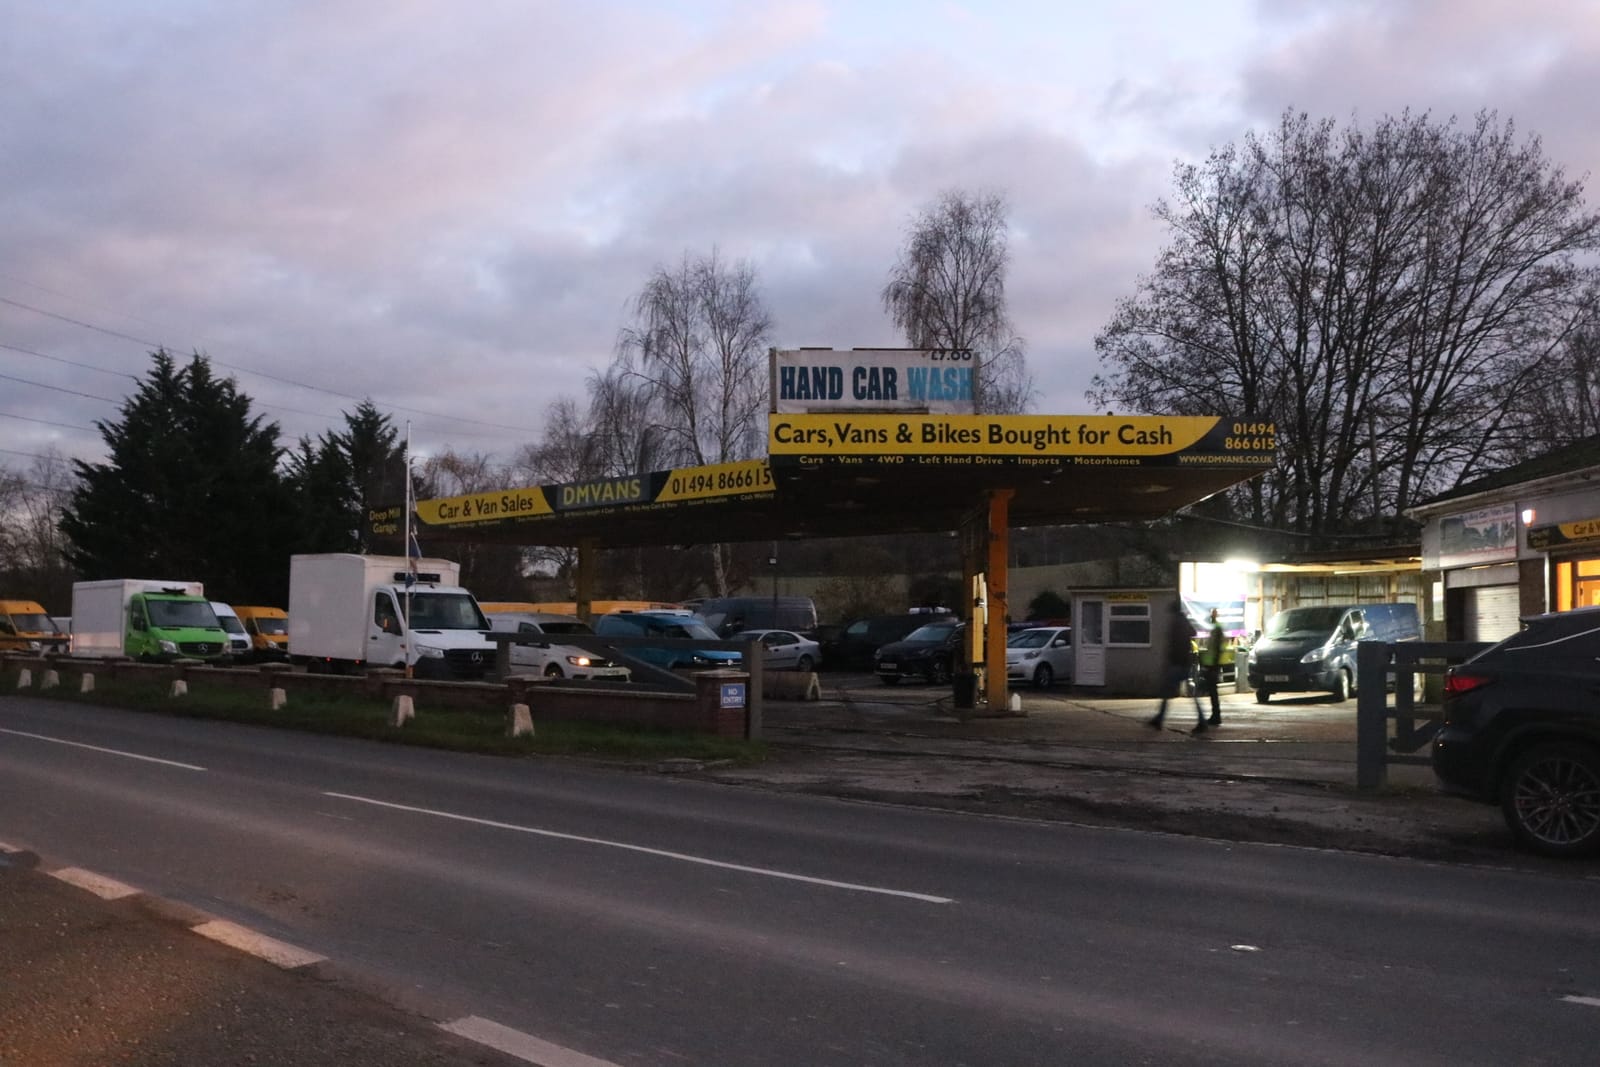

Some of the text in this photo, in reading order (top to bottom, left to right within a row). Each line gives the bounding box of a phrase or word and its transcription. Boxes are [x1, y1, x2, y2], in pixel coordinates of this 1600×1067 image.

[780, 366, 975, 401] HAND CAR WASH
[895, 423, 913, 444] &
[921, 423, 981, 444] Bikes
[988, 424, 1071, 449] Bought
[1077, 424, 1110, 445] for
[1118, 424, 1173, 445] Cash
[1233, 422, 1275, 435] 01494
[799, 456, 1141, 467] Cars Vans 4WD Left Hand Drive Imports Motorhomes
[563, 478, 641, 506] DMVANS
[672, 467, 771, 494] 01494 866615
[438, 495, 533, 519] Car & Van Sales
[728, 688, 737, 696] NO
